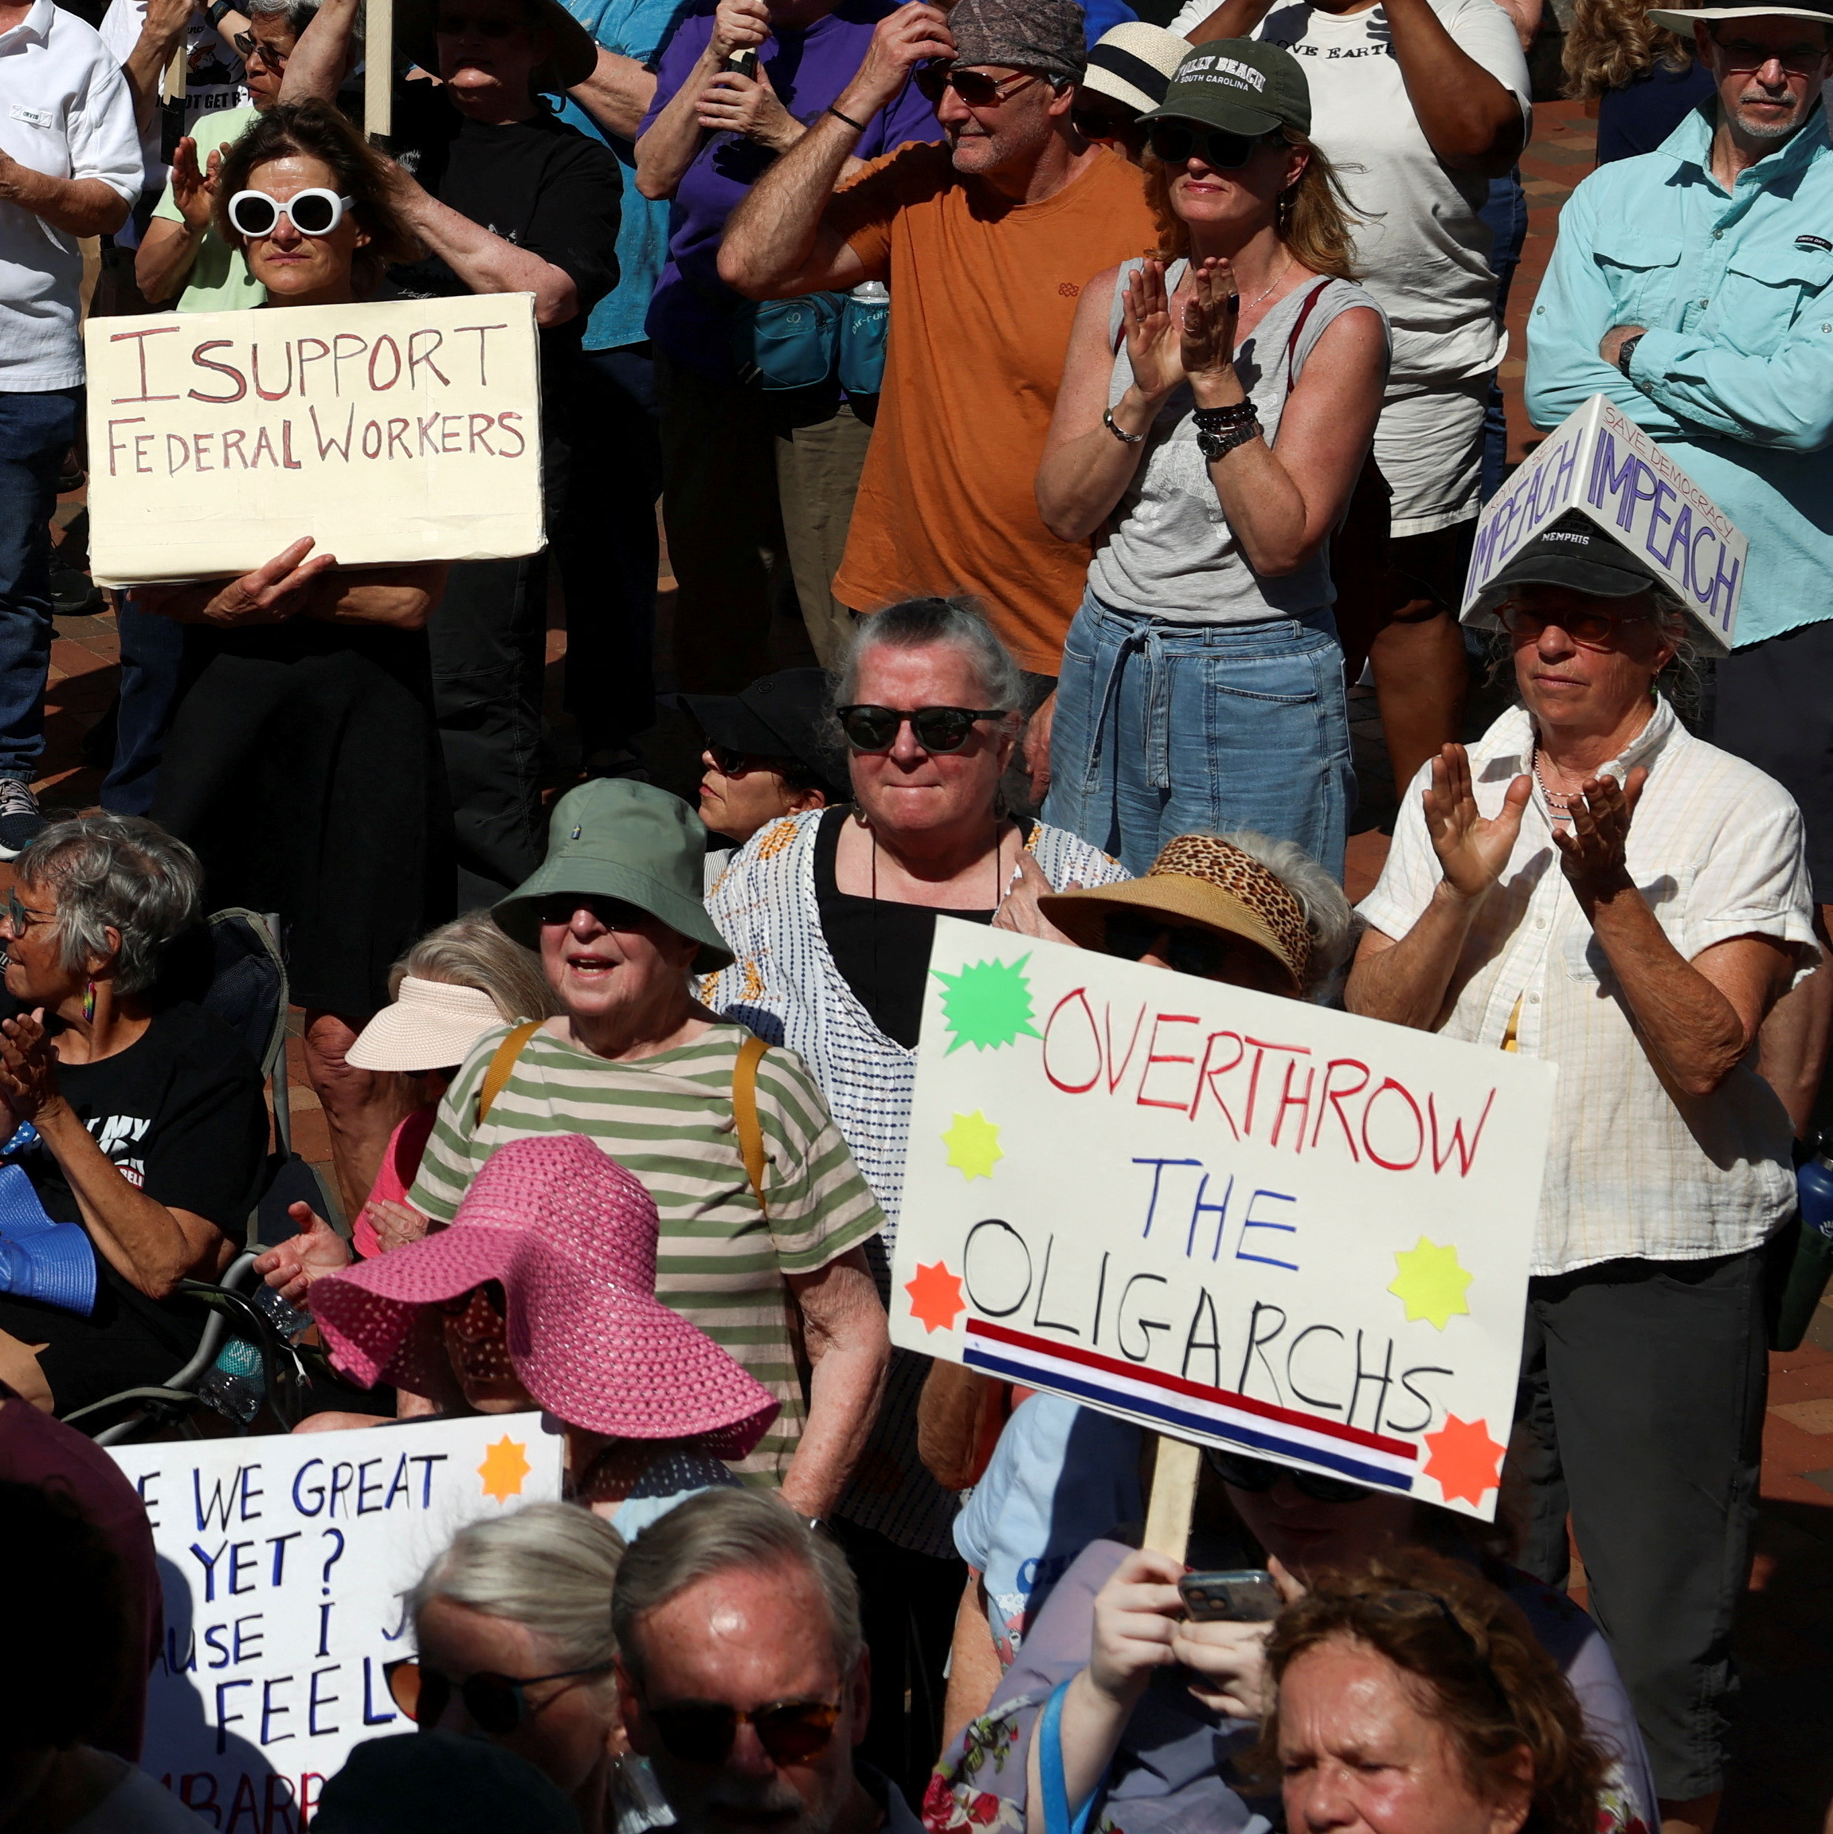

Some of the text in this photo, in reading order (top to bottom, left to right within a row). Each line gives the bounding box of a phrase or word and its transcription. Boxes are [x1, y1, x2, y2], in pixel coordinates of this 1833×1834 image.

[1215, 57, 1266, 92] BEACH
[110, 324, 507, 404] I SUPPORT
[108, 403, 525, 477] FEDERAL WORKERS
[1542, 532, 1589, 544] MEMPHIS
[1589, 430, 1739, 632] IMPEACH
[1044, 988, 1495, 1177] OVERTHROW
[1132, 1158, 1299, 1271] THE
[962, 1216, 1454, 1435] OLIGARCHS
